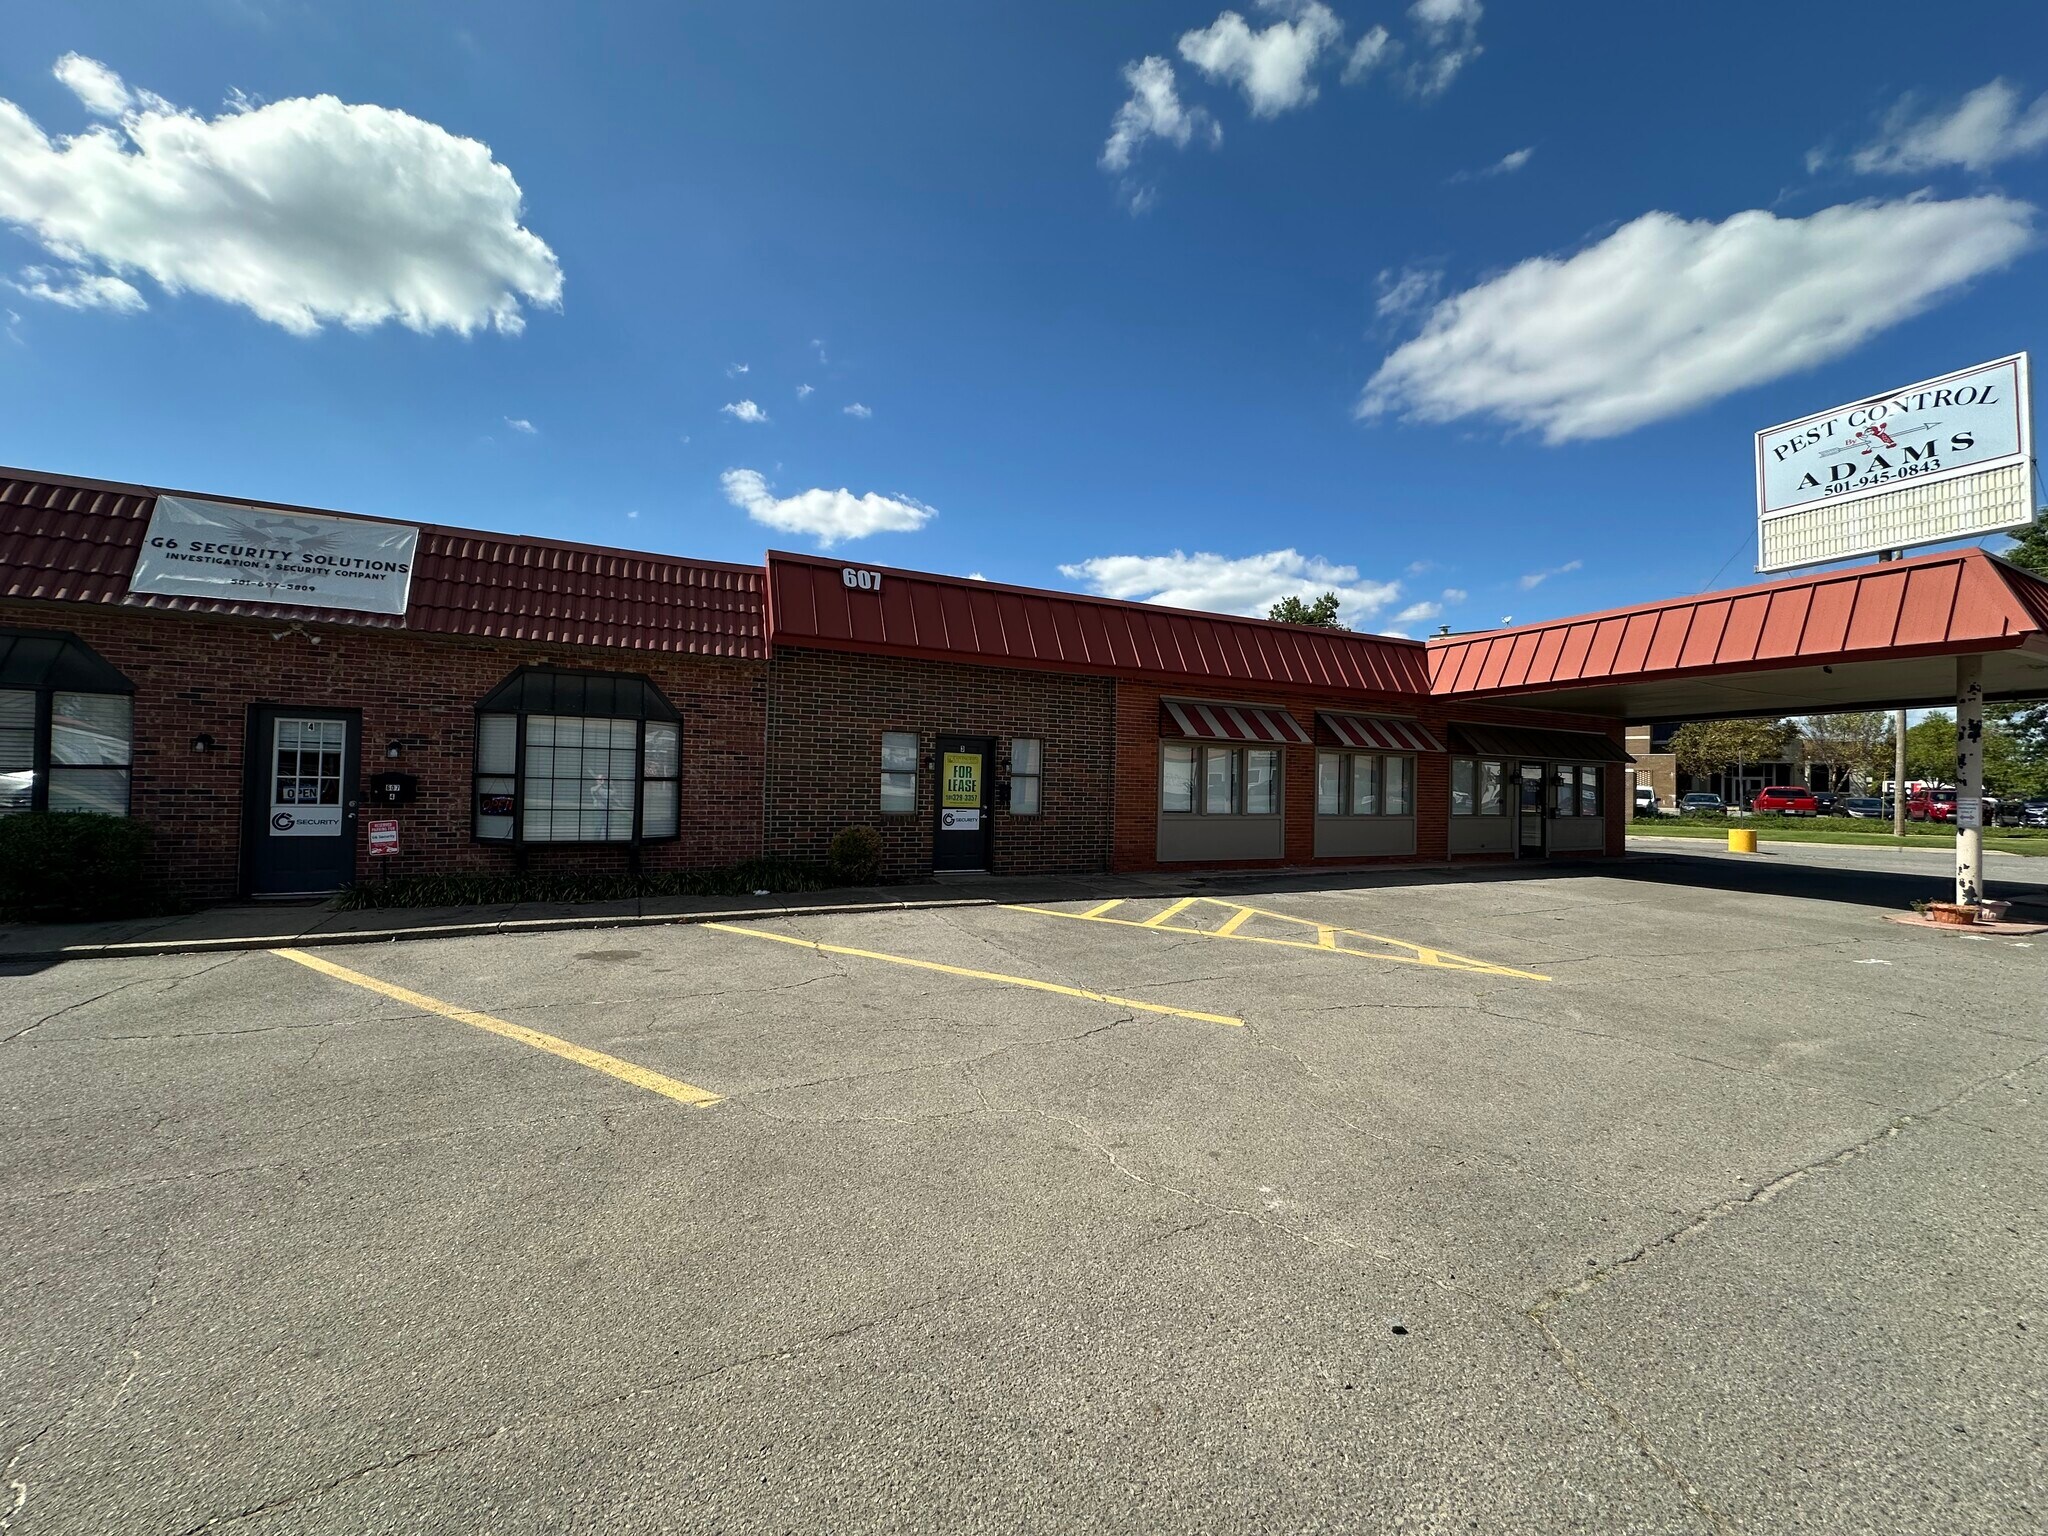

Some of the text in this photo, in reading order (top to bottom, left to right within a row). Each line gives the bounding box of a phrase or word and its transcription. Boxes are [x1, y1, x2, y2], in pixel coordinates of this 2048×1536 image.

[1773, 385, 2000, 462] PEST CONTROL
[1845, 438, 1858, 446] By
[1796, 431, 1975, 491] ADAMS
[1824, 459, 1941, 496] 501-945-0843
[151, 537, 409, 574] G6 SECURITY SOLUTIONS
[166, 552, 259, 568] INVESTIGATION
[276, 563, 330, 575] SECURITY
[335, 569, 387, 581] COMPANY
[842, 567, 881, 591] 607
[308, 723, 314, 731] 4
[953, 765, 972, 778] FOR
[947, 779, 977, 792] LEASE
